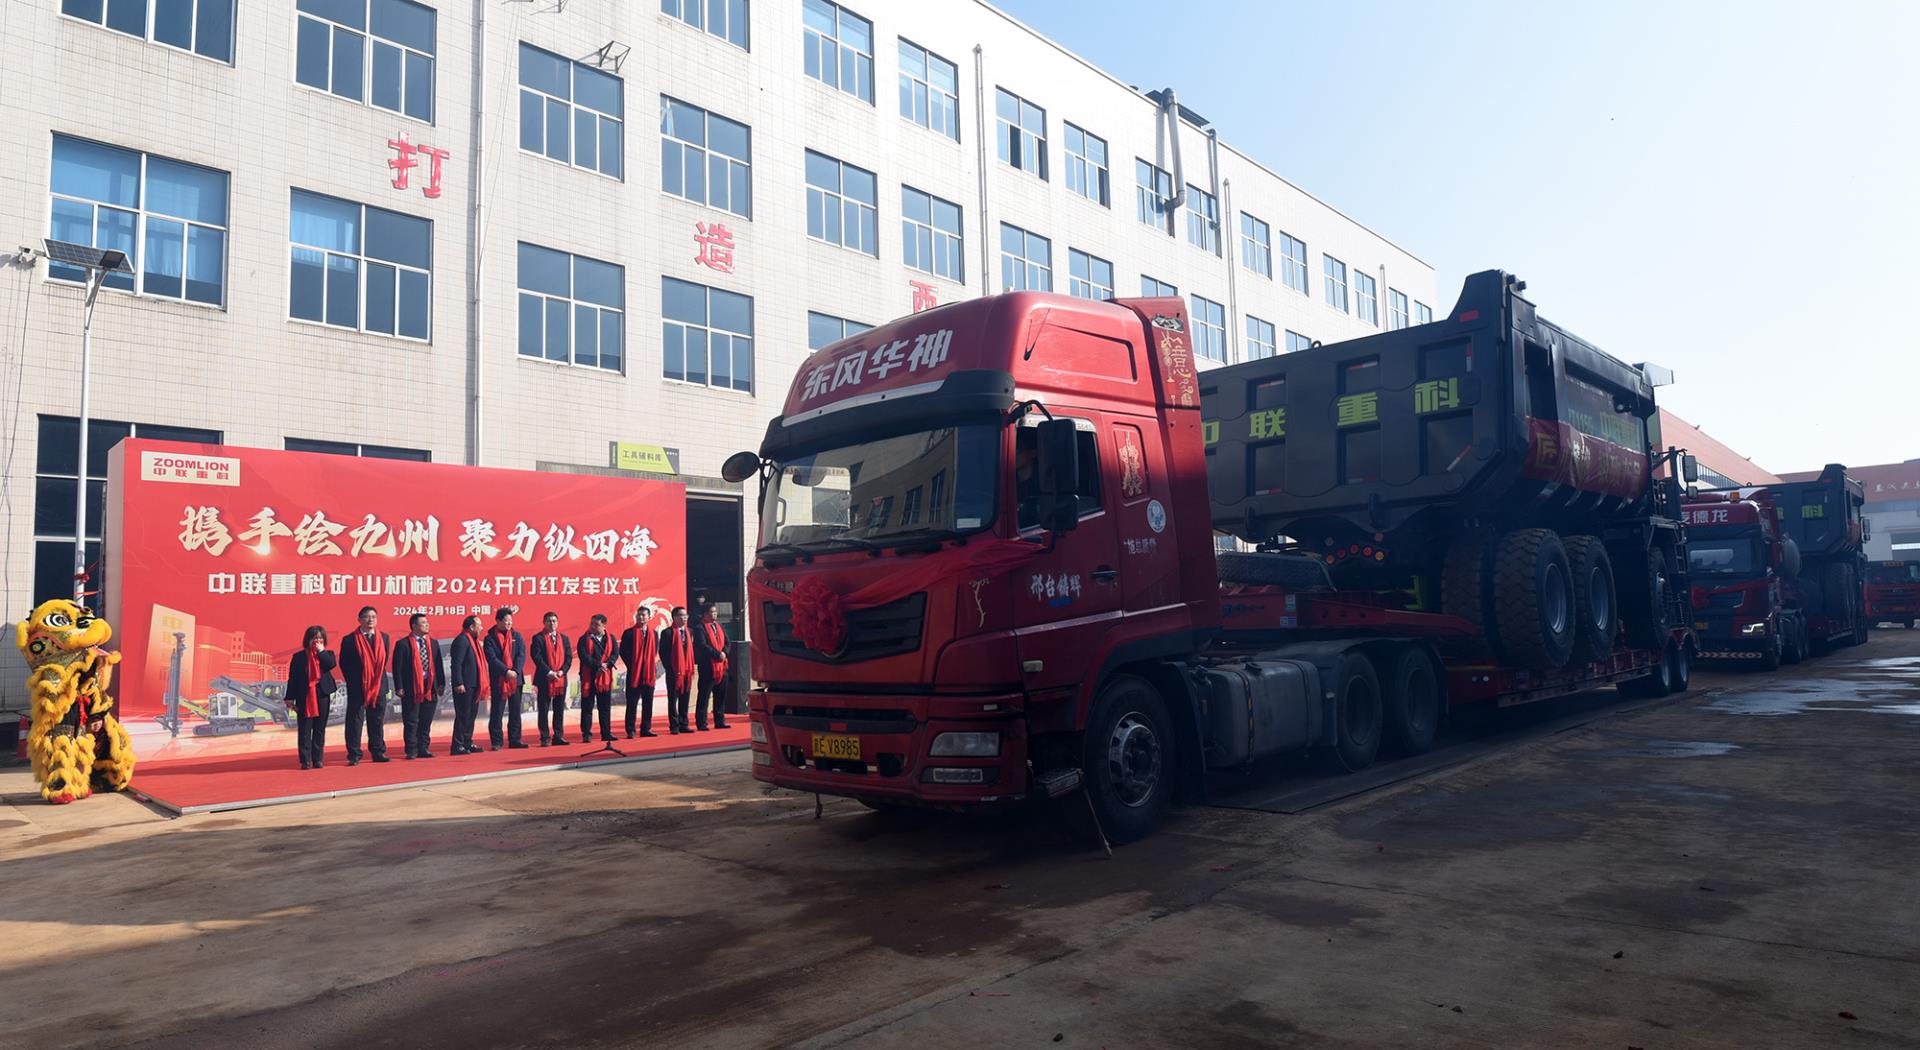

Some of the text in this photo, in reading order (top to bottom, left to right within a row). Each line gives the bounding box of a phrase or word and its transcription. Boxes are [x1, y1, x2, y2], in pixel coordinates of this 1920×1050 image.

[387, 131, 450, 198] 打
[694, 222, 736, 274] 造
[803, 329, 952, 400] 东风华神
[153, 457, 229, 471] ZOOMLION
[153, 467, 229, 480] 中联重科
[178, 505, 659, 566] 携手绘九州 聚力纵四海
[208, 571, 641, 598] 中联重科矿山机械2024开门红发车仪式
[393, 605, 465, 617] 2024年2月18日
